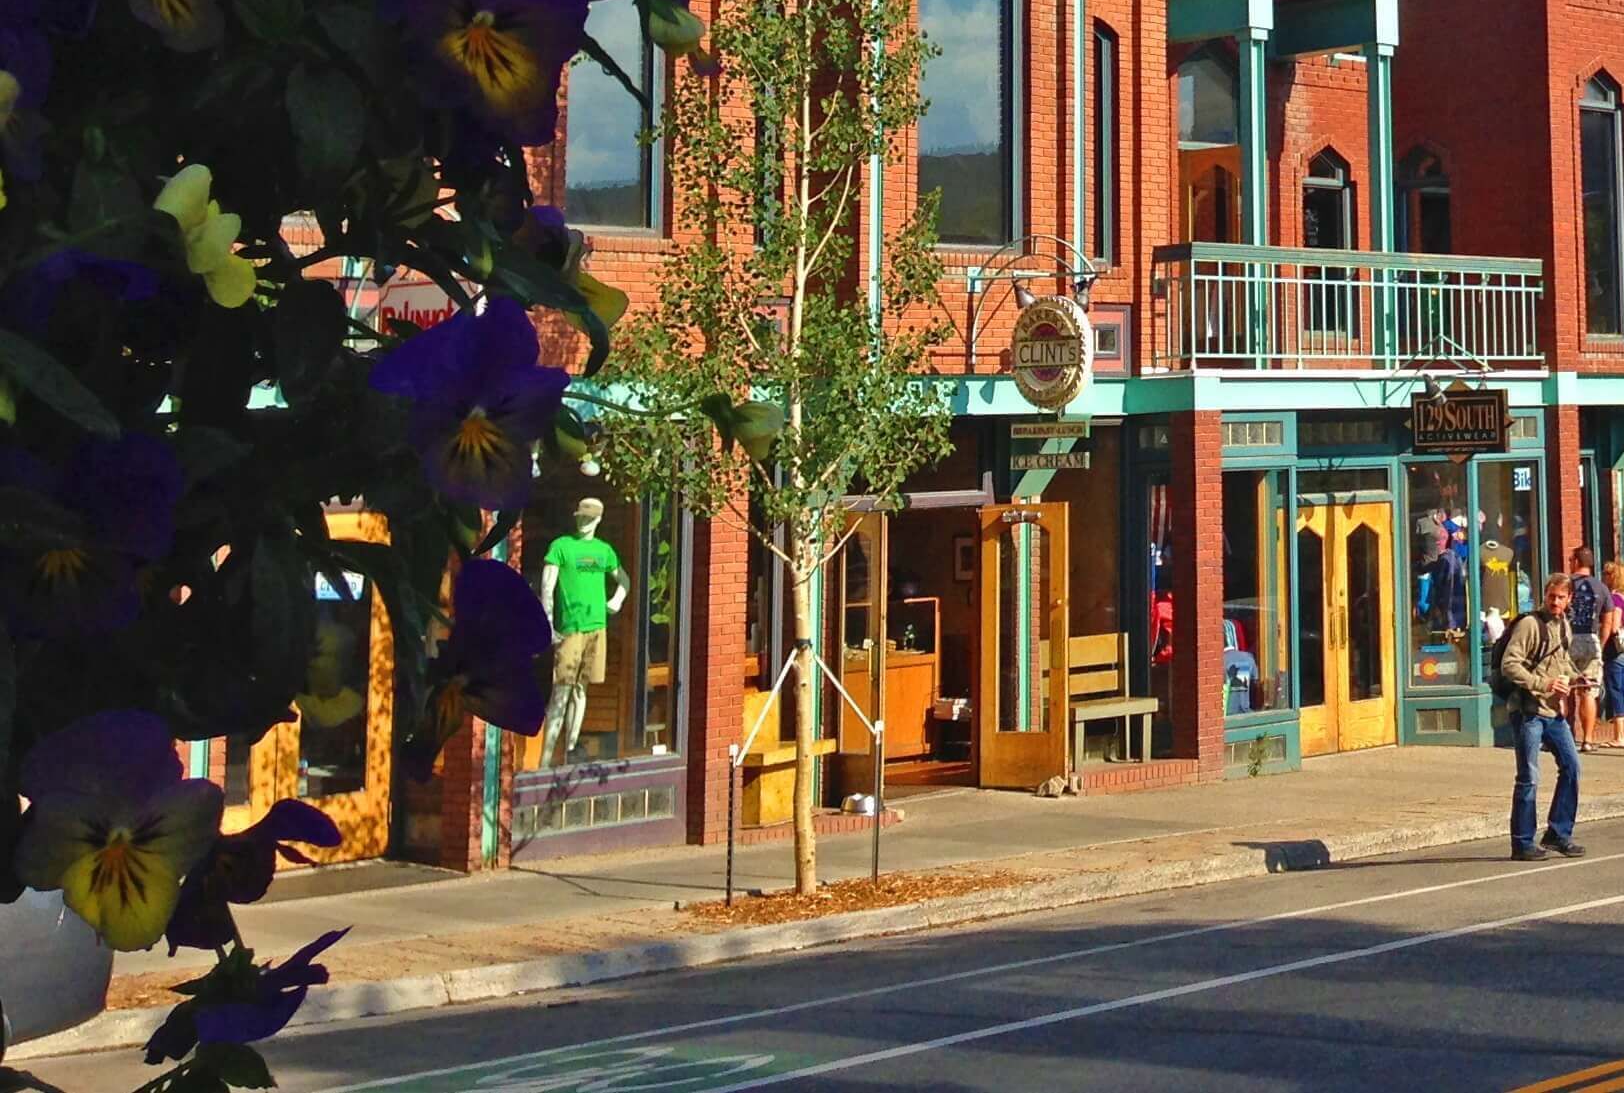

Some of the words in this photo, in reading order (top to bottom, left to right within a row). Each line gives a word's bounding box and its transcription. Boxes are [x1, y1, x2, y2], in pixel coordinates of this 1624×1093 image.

[1418, 403, 1443, 431] 129
[1013, 454, 1033, 468] ICE
[1036, 452, 1085, 468] CREAM
